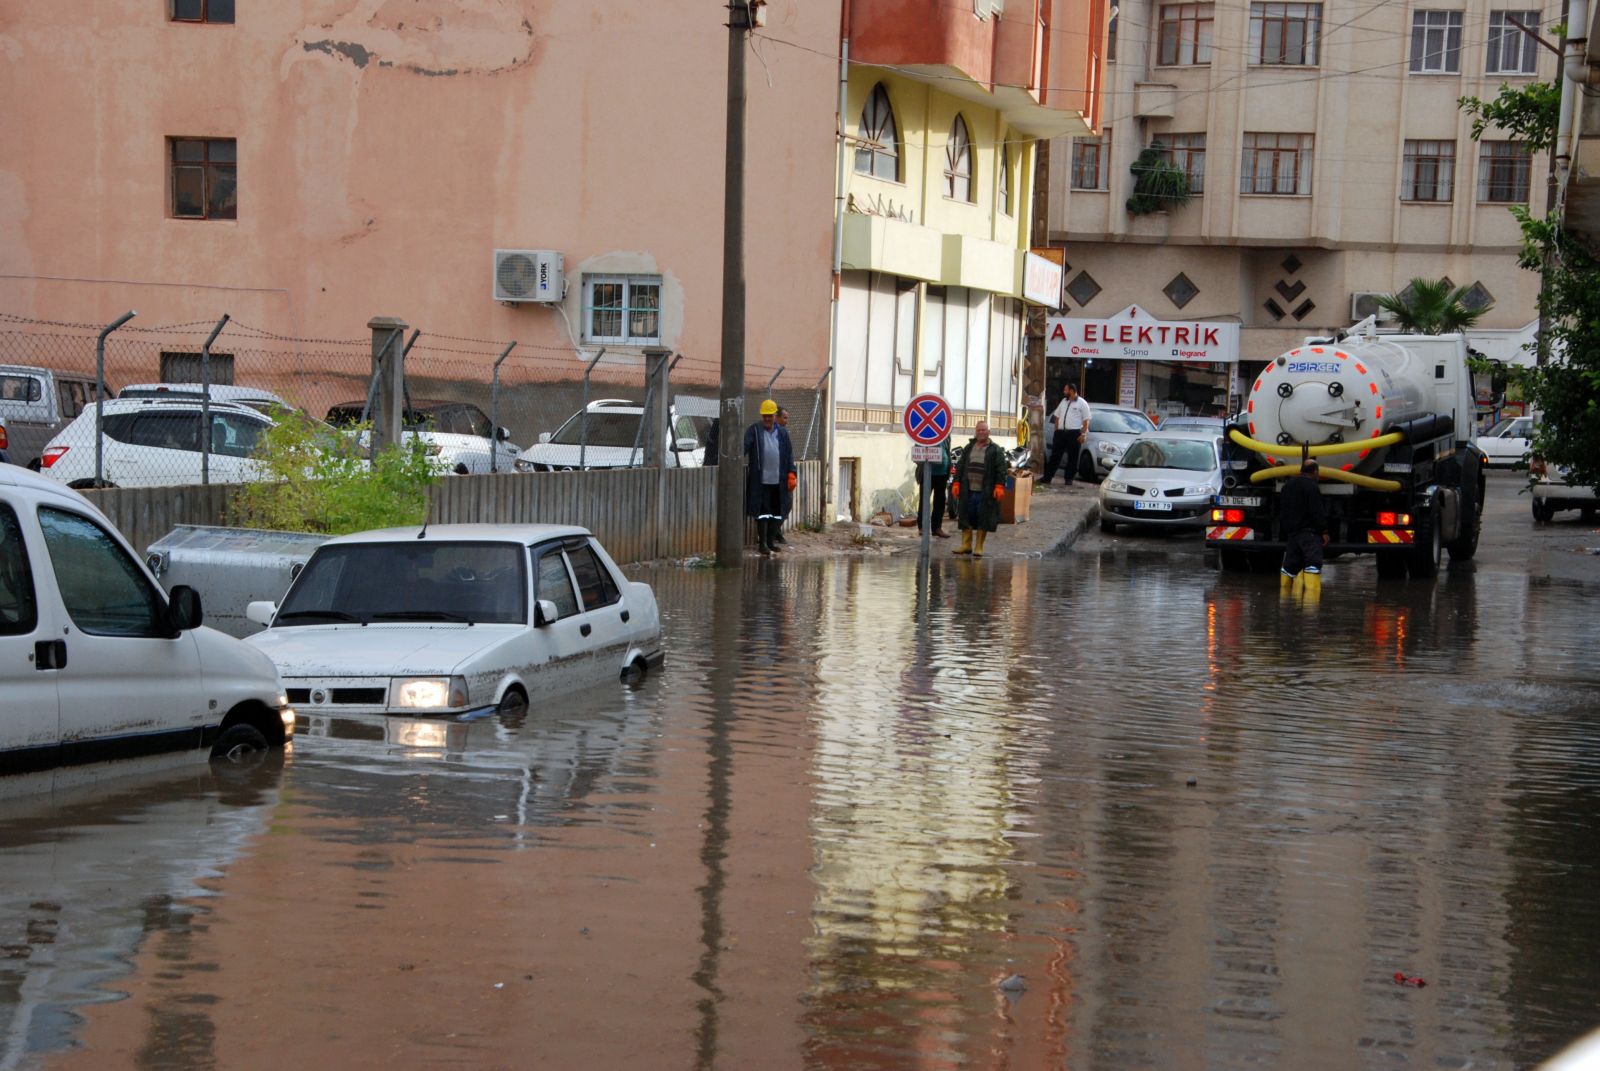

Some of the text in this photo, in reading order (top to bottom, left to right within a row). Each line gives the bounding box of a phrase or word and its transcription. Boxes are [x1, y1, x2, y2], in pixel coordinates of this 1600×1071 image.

[1046, 323, 1220, 346] A ELEKTRİK
[1123, 347, 1149, 357] Sigma
[1179, 349, 1207, 358] legrand
